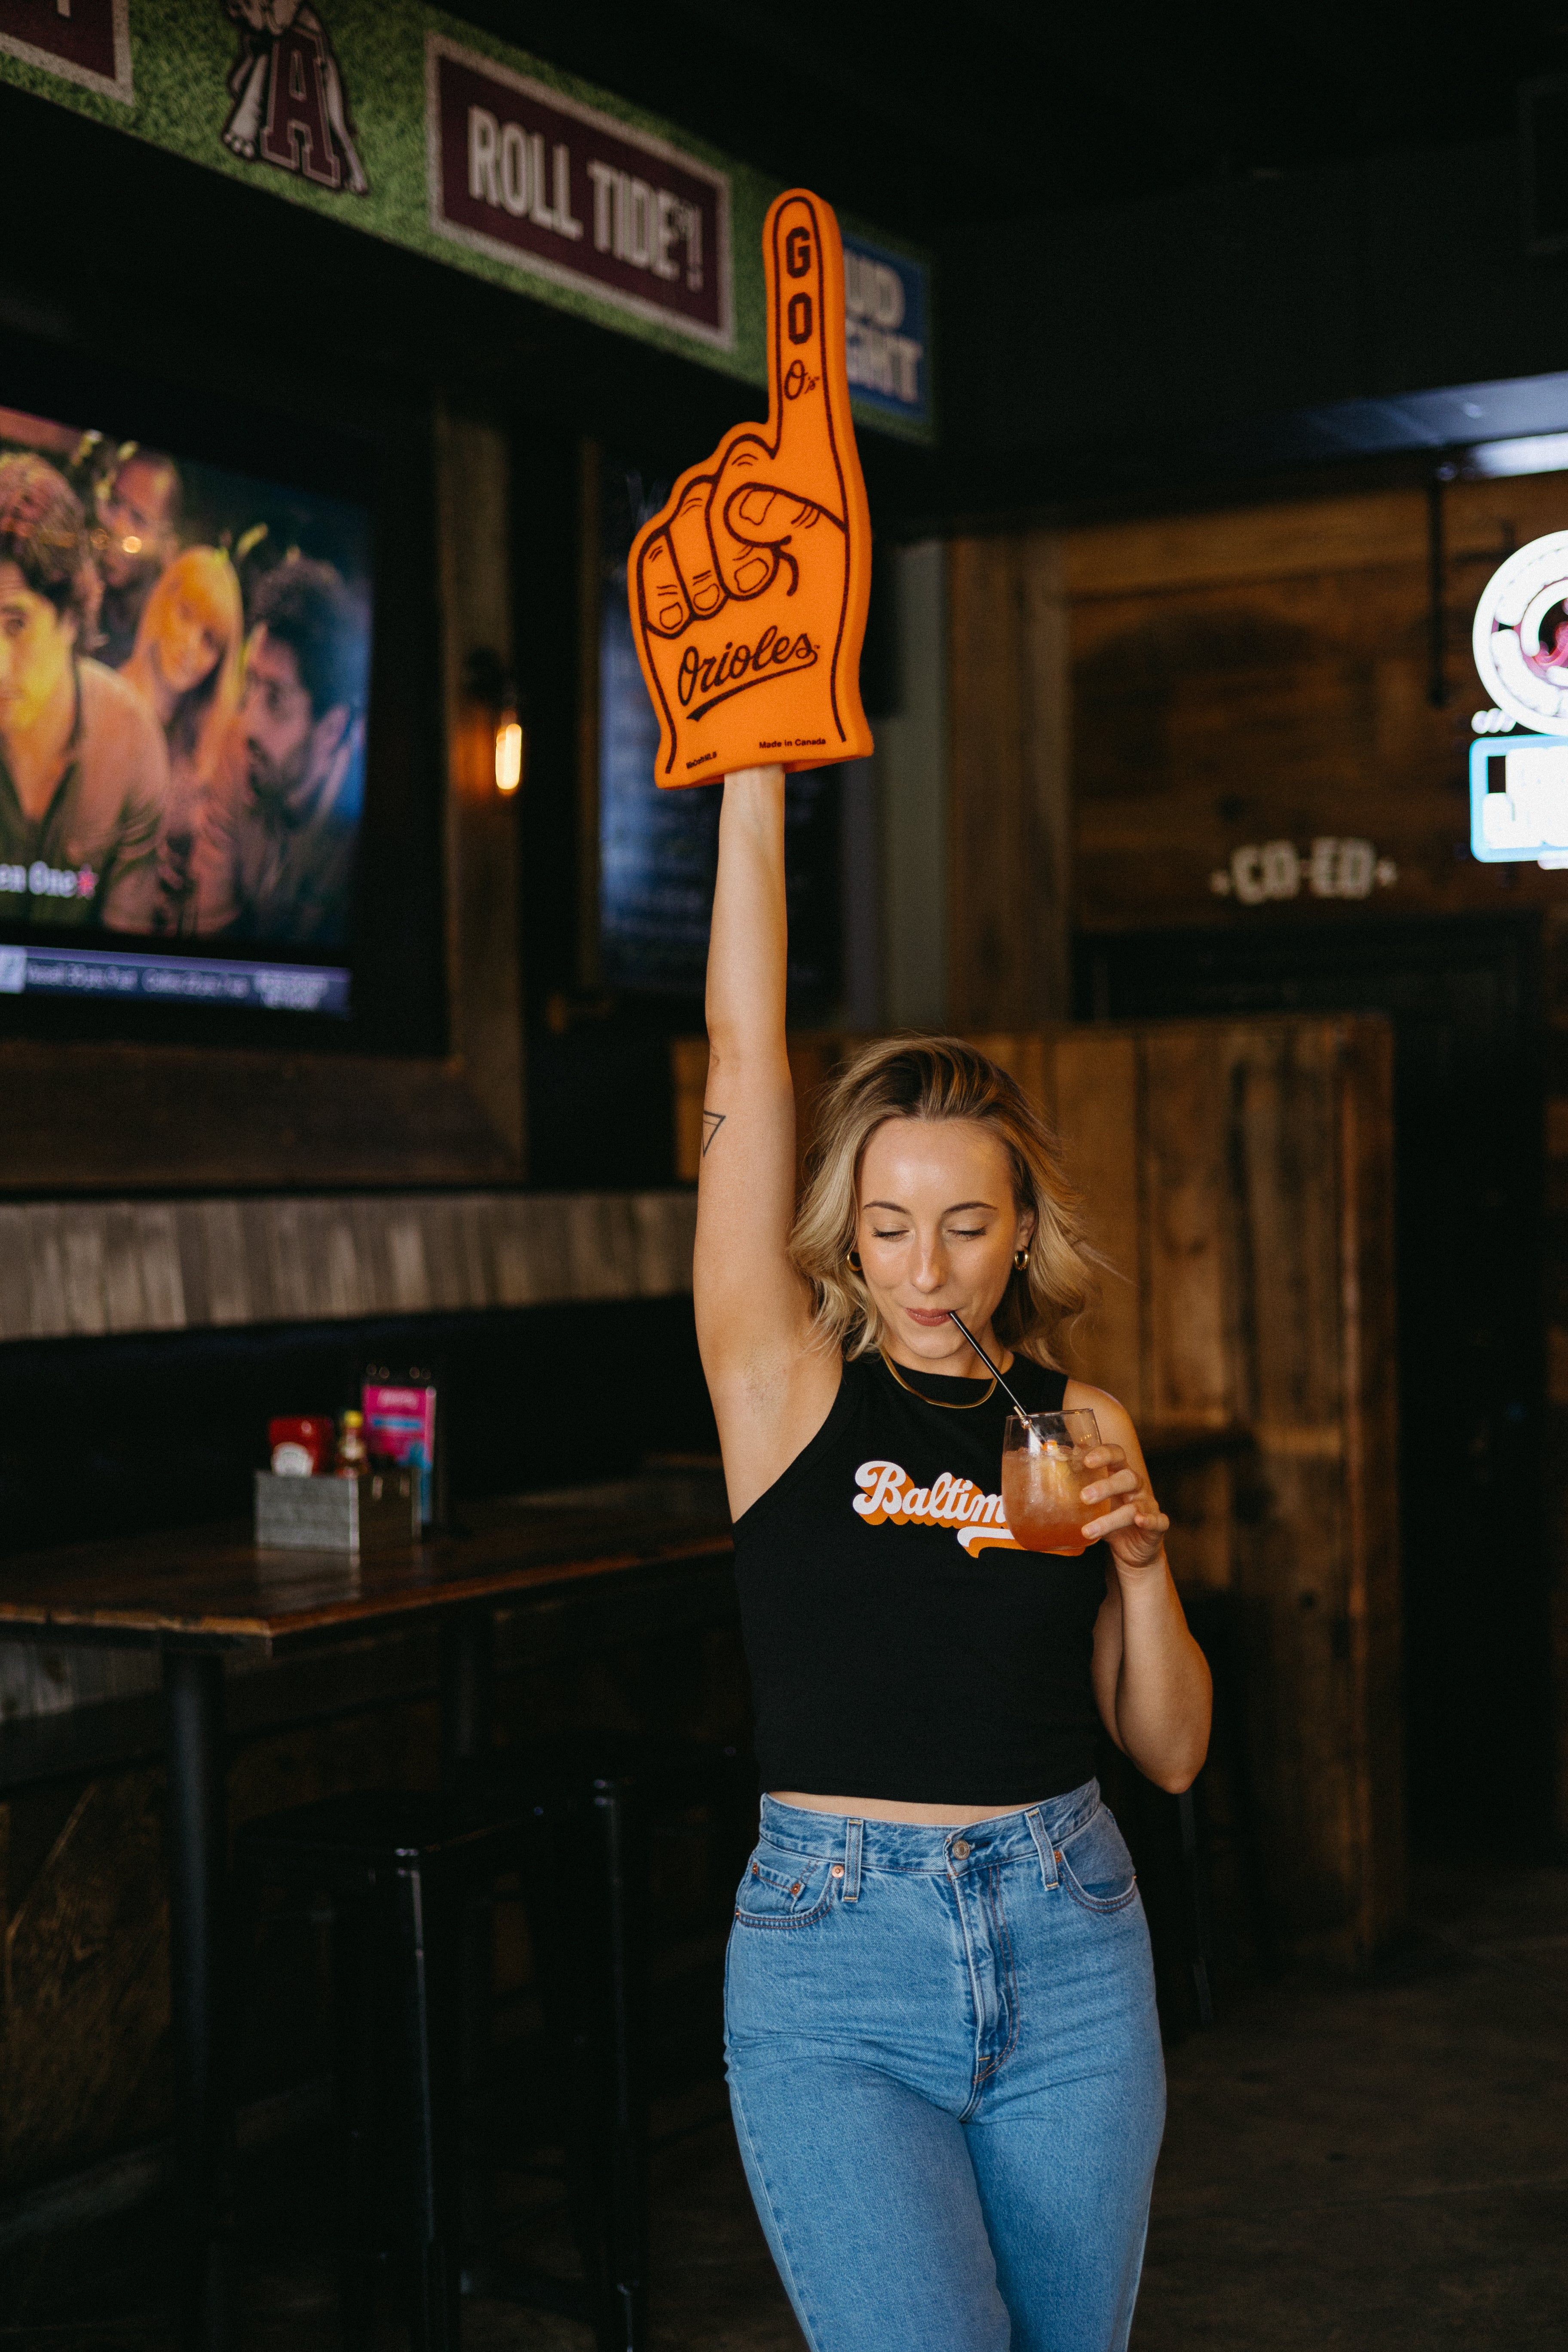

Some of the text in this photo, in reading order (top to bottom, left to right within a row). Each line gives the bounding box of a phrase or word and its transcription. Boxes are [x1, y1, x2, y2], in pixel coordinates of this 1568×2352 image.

[468, 106, 584, 242] ROLL
[678, 625, 817, 706] Orioles
[795, 738, 826, 746] Canada
[1231, 836, 1375, 905] CO-ED
[853, 1461, 1008, 1525] Baltim
